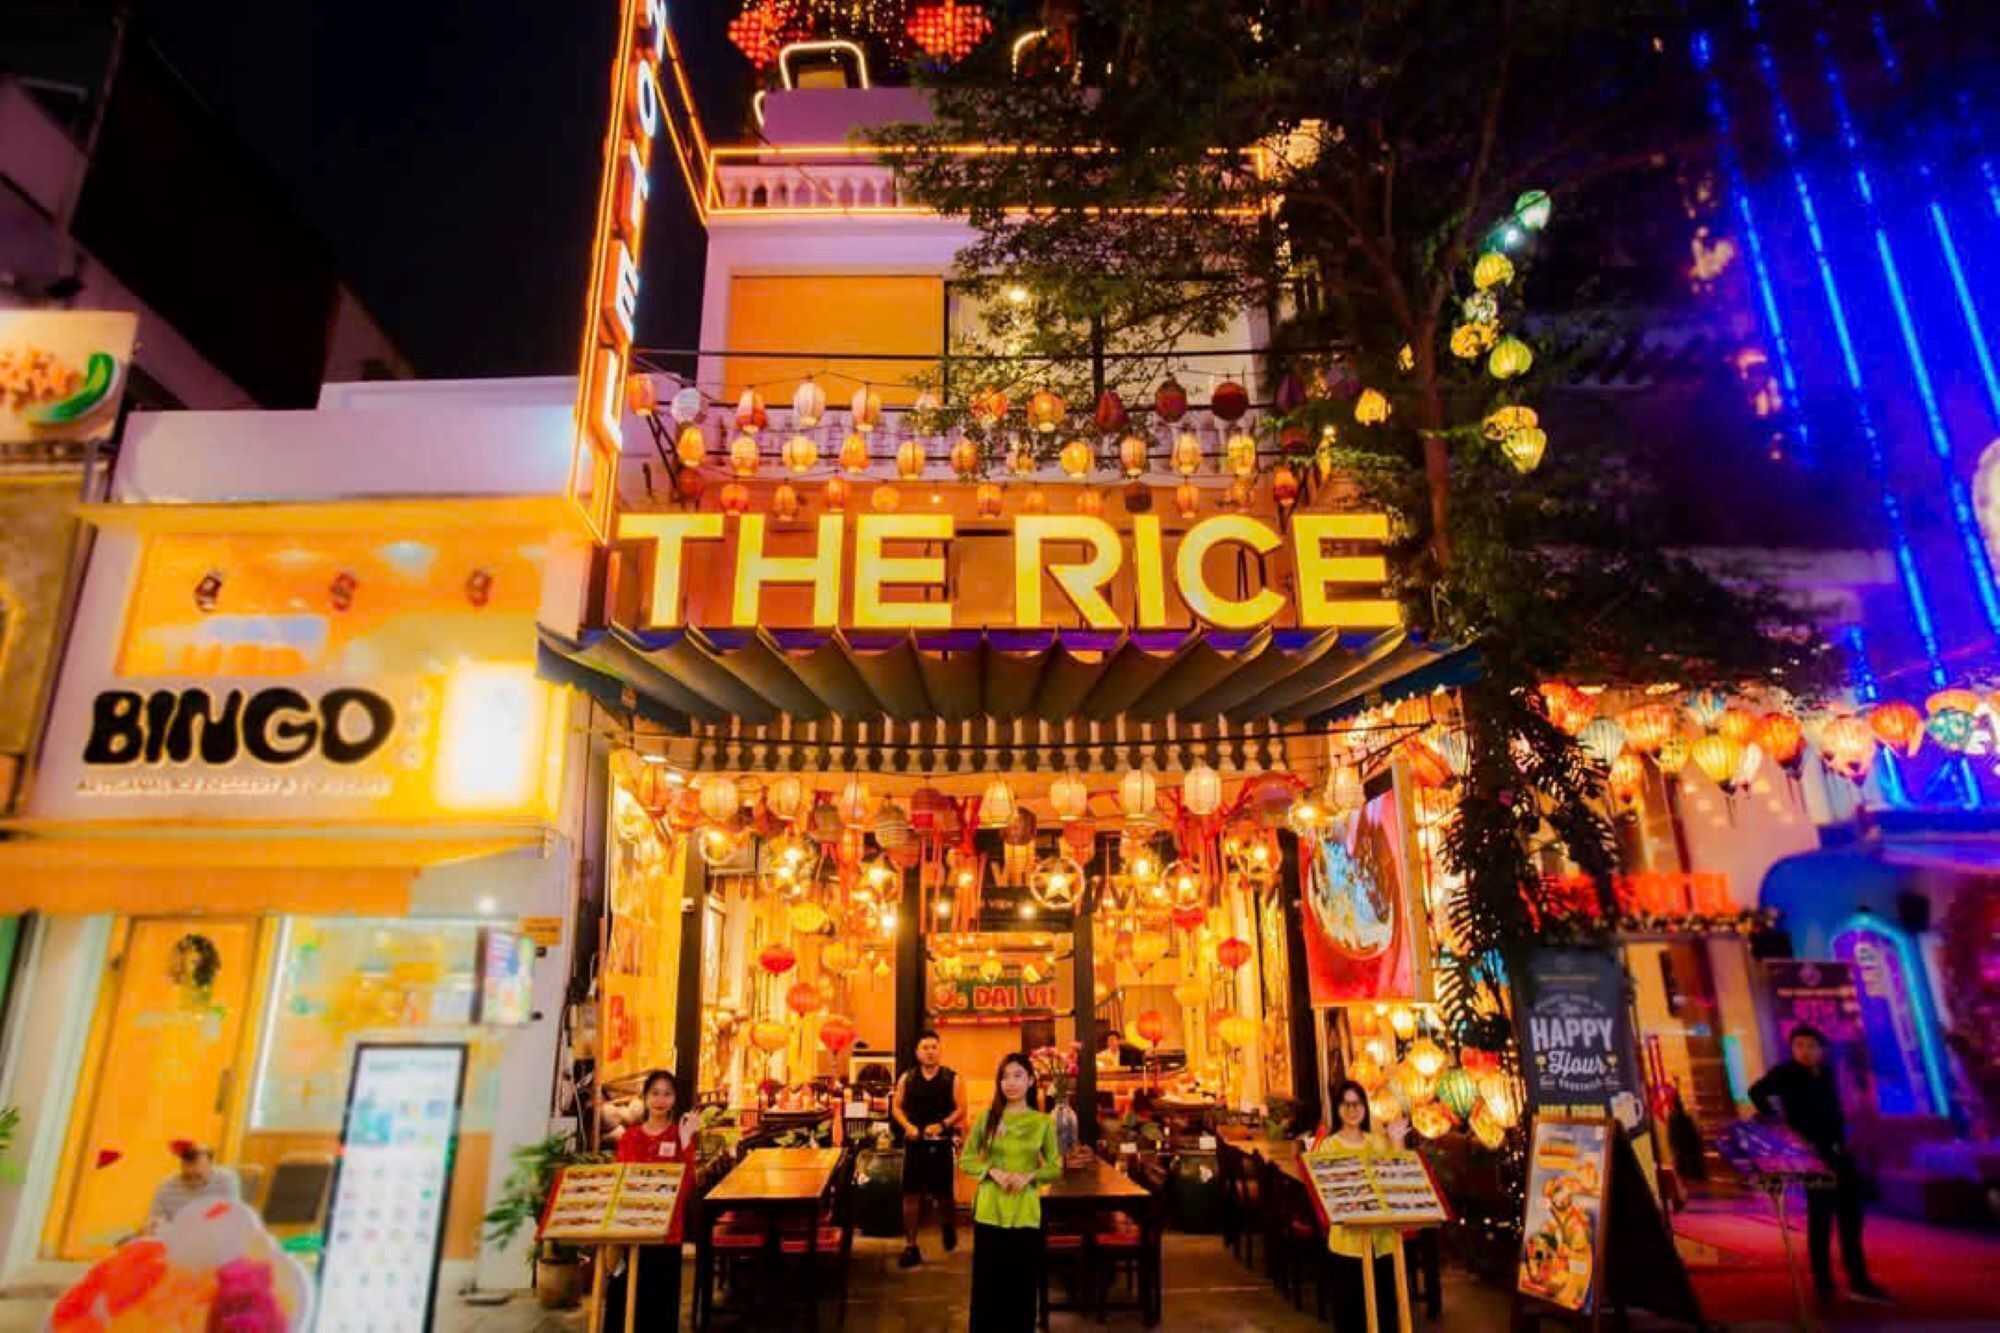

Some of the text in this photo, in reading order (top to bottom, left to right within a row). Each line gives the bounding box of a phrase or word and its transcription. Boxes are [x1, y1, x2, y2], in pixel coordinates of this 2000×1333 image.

[617, 513, 1403, 628] THE RICE
[84, 687, 396, 764] BINGO
[1530, 1016, 1614, 1052] HAPPY
